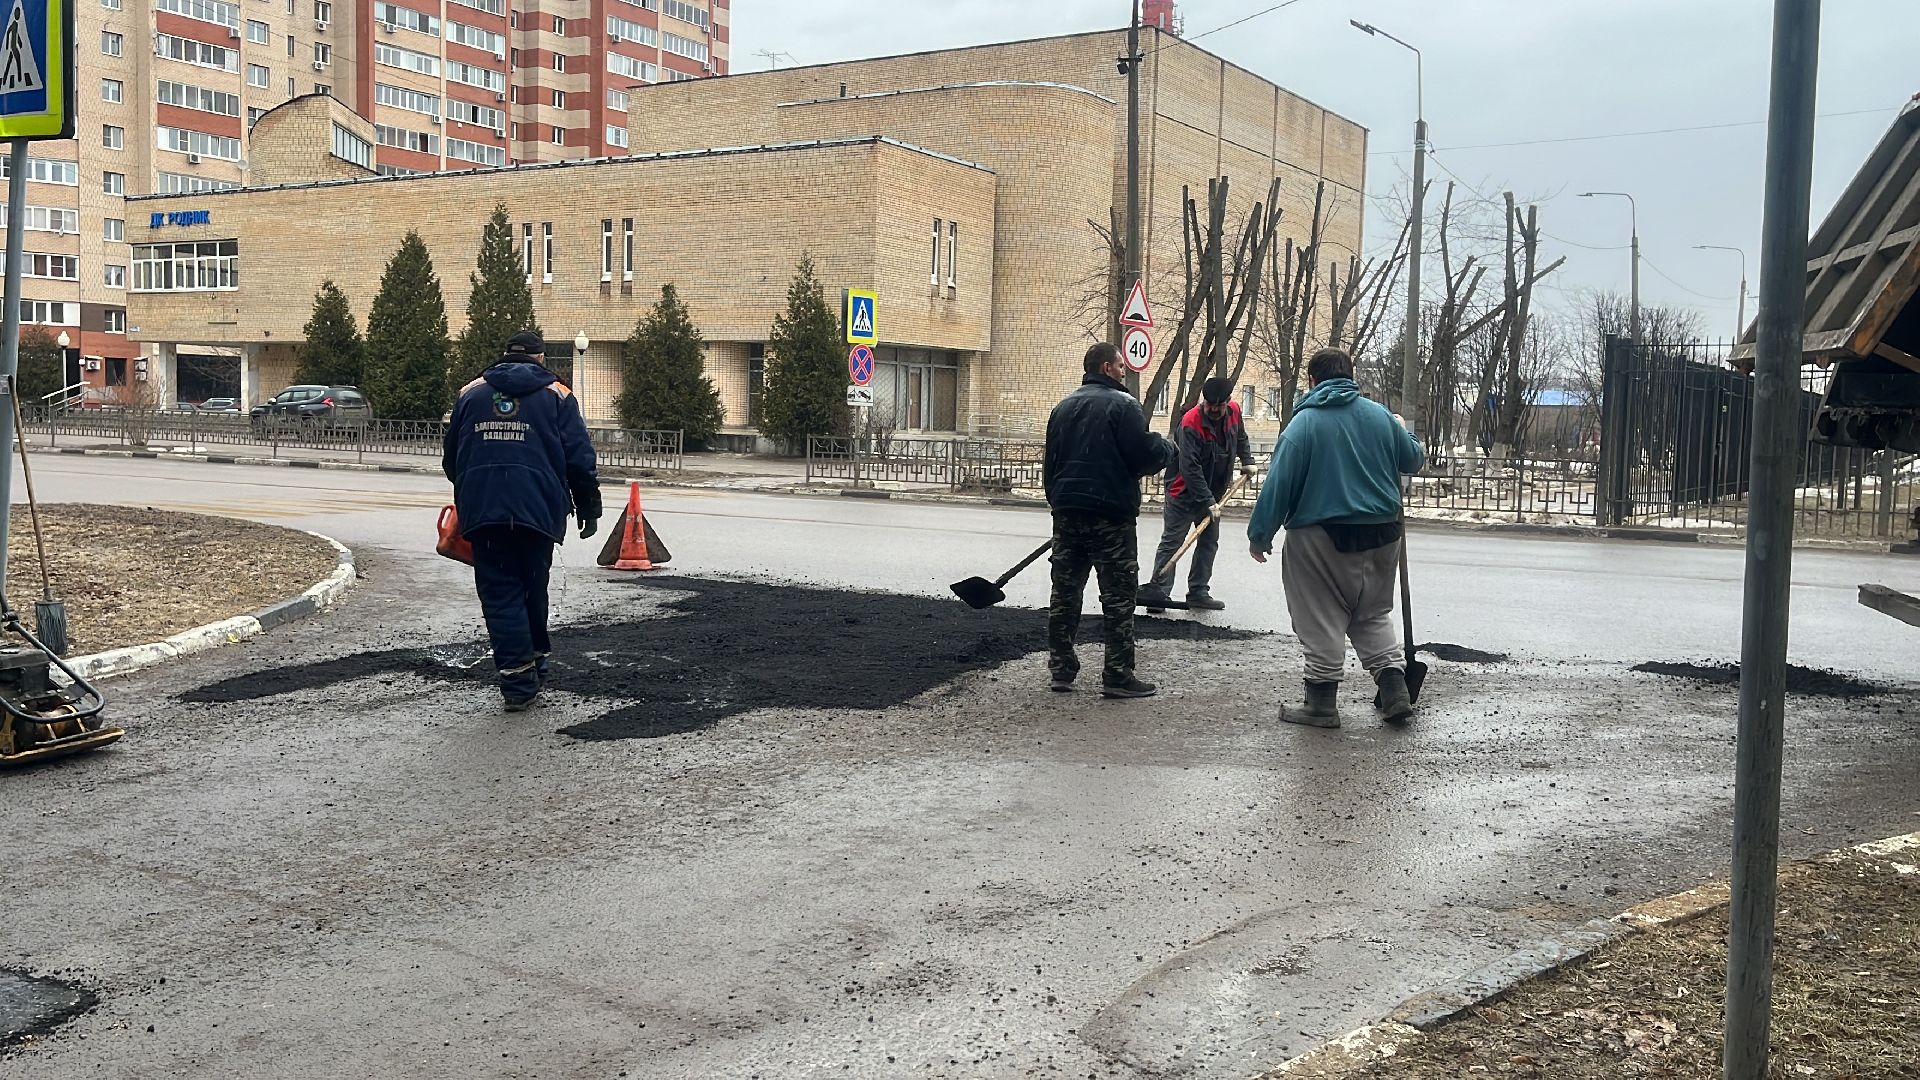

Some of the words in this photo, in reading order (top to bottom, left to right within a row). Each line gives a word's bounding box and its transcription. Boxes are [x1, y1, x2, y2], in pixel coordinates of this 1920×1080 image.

[150, 211, 164, 229] ДК
[168, 209, 210, 226] РОДНИК
[1129, 340, 1147, 358] 40
[474, 421, 532, 432] БЛАГОУСТРОЙСТ
[483, 431, 525, 441] БАЛАШИХА
